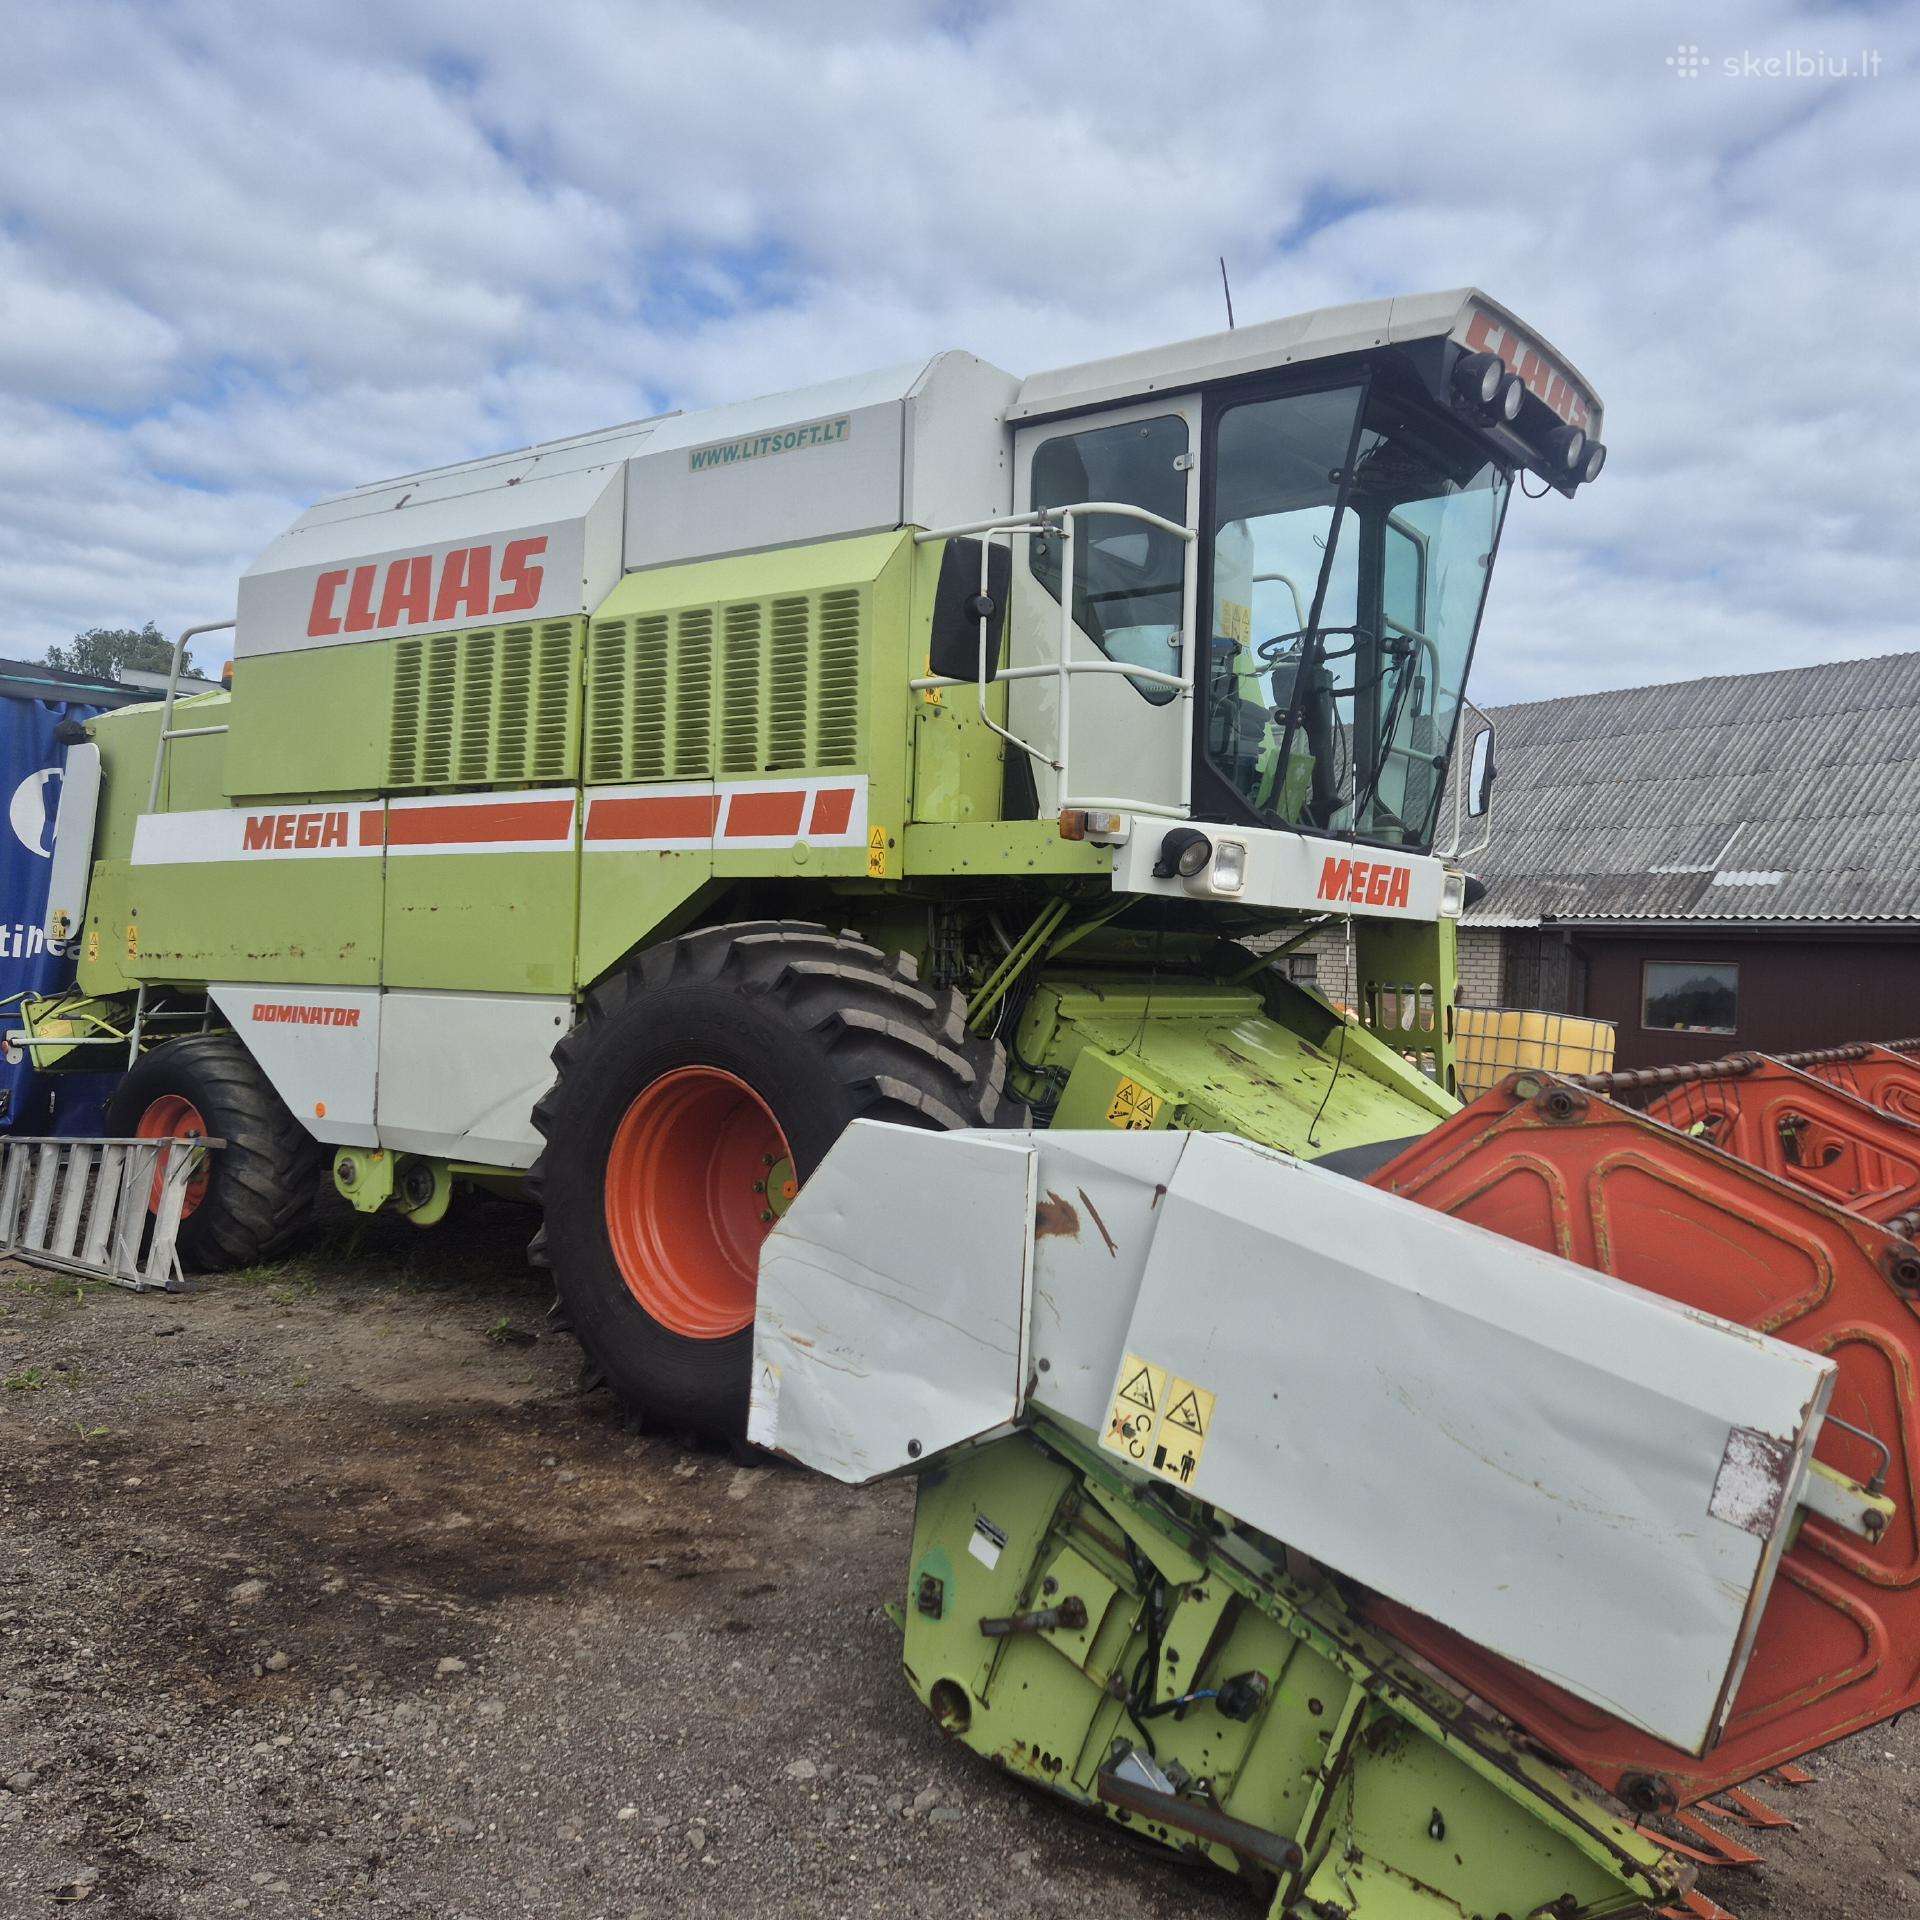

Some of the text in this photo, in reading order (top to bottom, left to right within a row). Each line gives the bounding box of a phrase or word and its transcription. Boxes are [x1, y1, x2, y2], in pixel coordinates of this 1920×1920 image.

[691, 420, 848, 469] WWW.LITSOFT.LT
[307, 535, 549, 637] CLAAS
[242, 811, 349, 850] MEGA
[1317, 857, 1411, 907] MEGA
[252, 1004, 360, 1027] DOMINATOR
